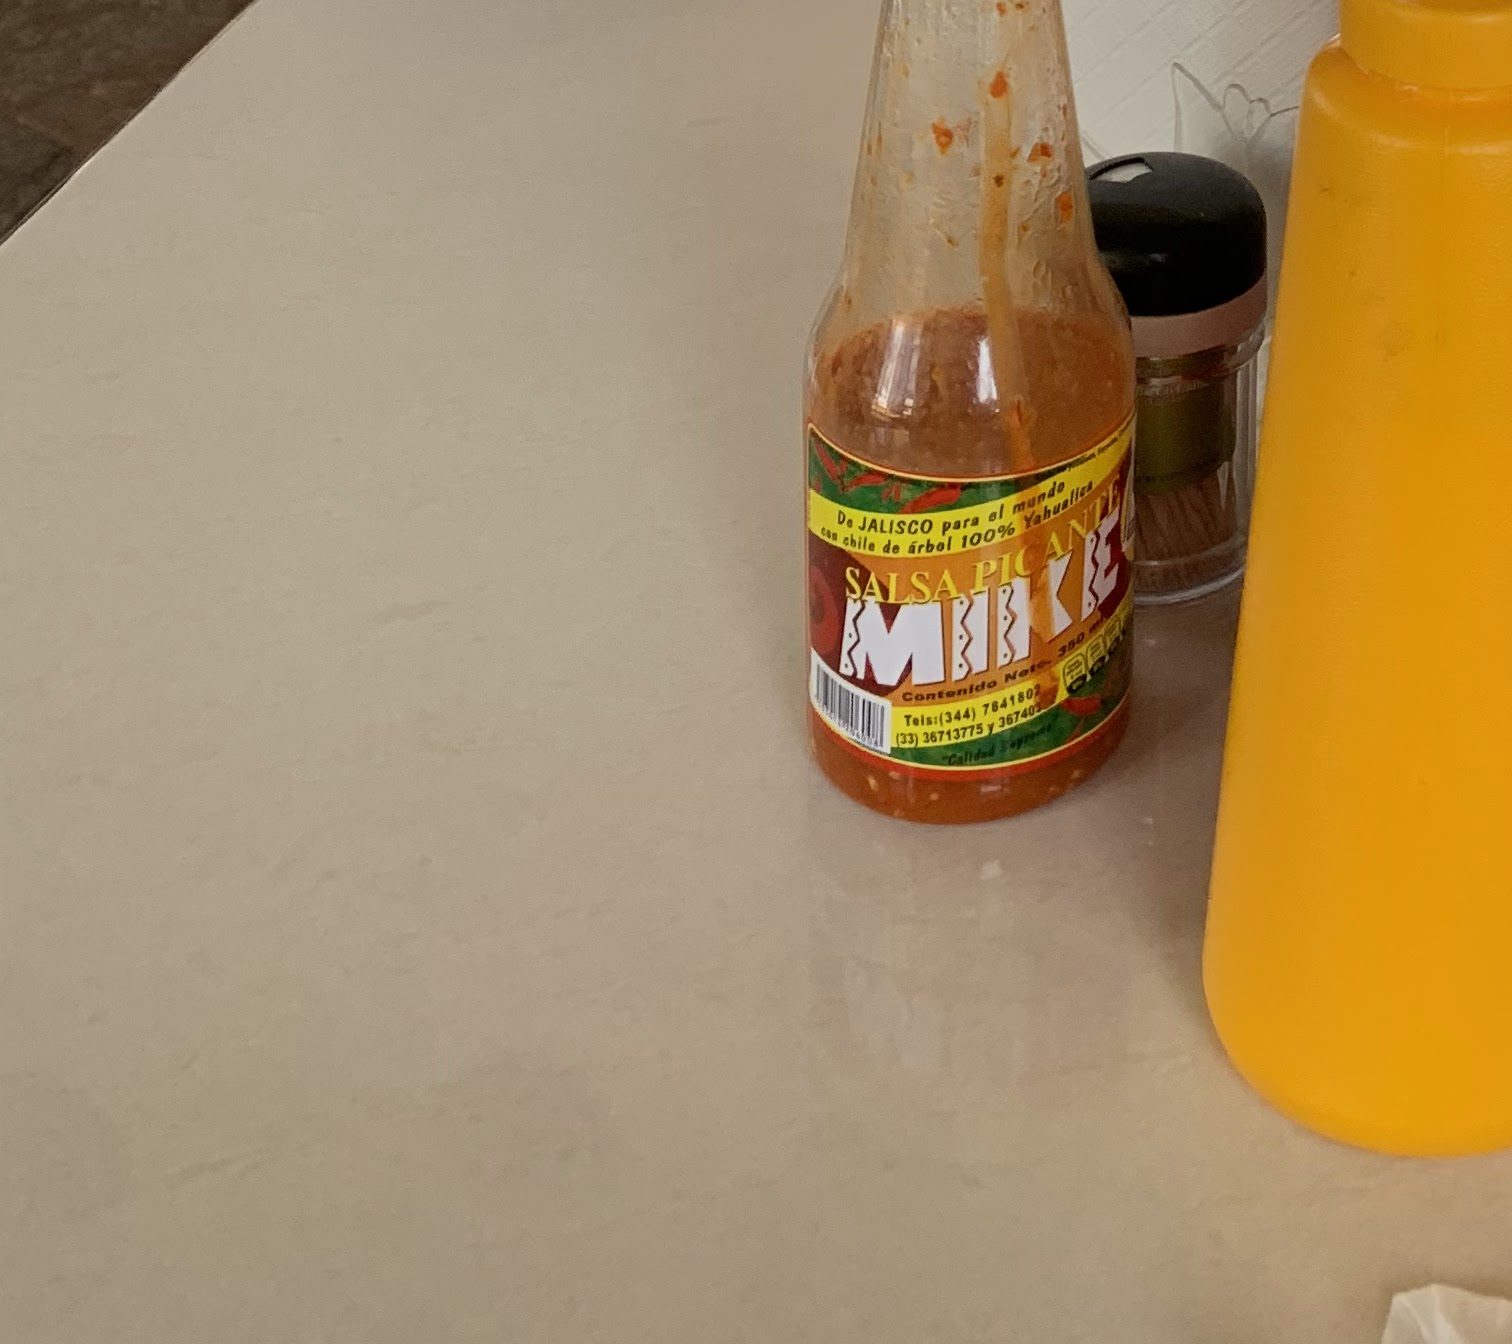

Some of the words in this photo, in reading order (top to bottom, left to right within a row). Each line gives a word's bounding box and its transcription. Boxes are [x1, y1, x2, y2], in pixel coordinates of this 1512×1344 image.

[837, 509, 853, 528] De
[858, 516, 933, 535] JALISCO
[941, 516, 979, 536] para
[988, 503, 1005, 522] el
[1012, 481, 1065, 515] mundo
[843, 533, 875, 553] chile
[882, 539, 901, 554] de
[907, 536, 952, 555] árbol
[961, 522, 1016, 549] 100%
[837, 506, 1120, 687] MIKE
[845, 566, 961, 605] SALSA
[901, 679, 998, 702] Contenido
